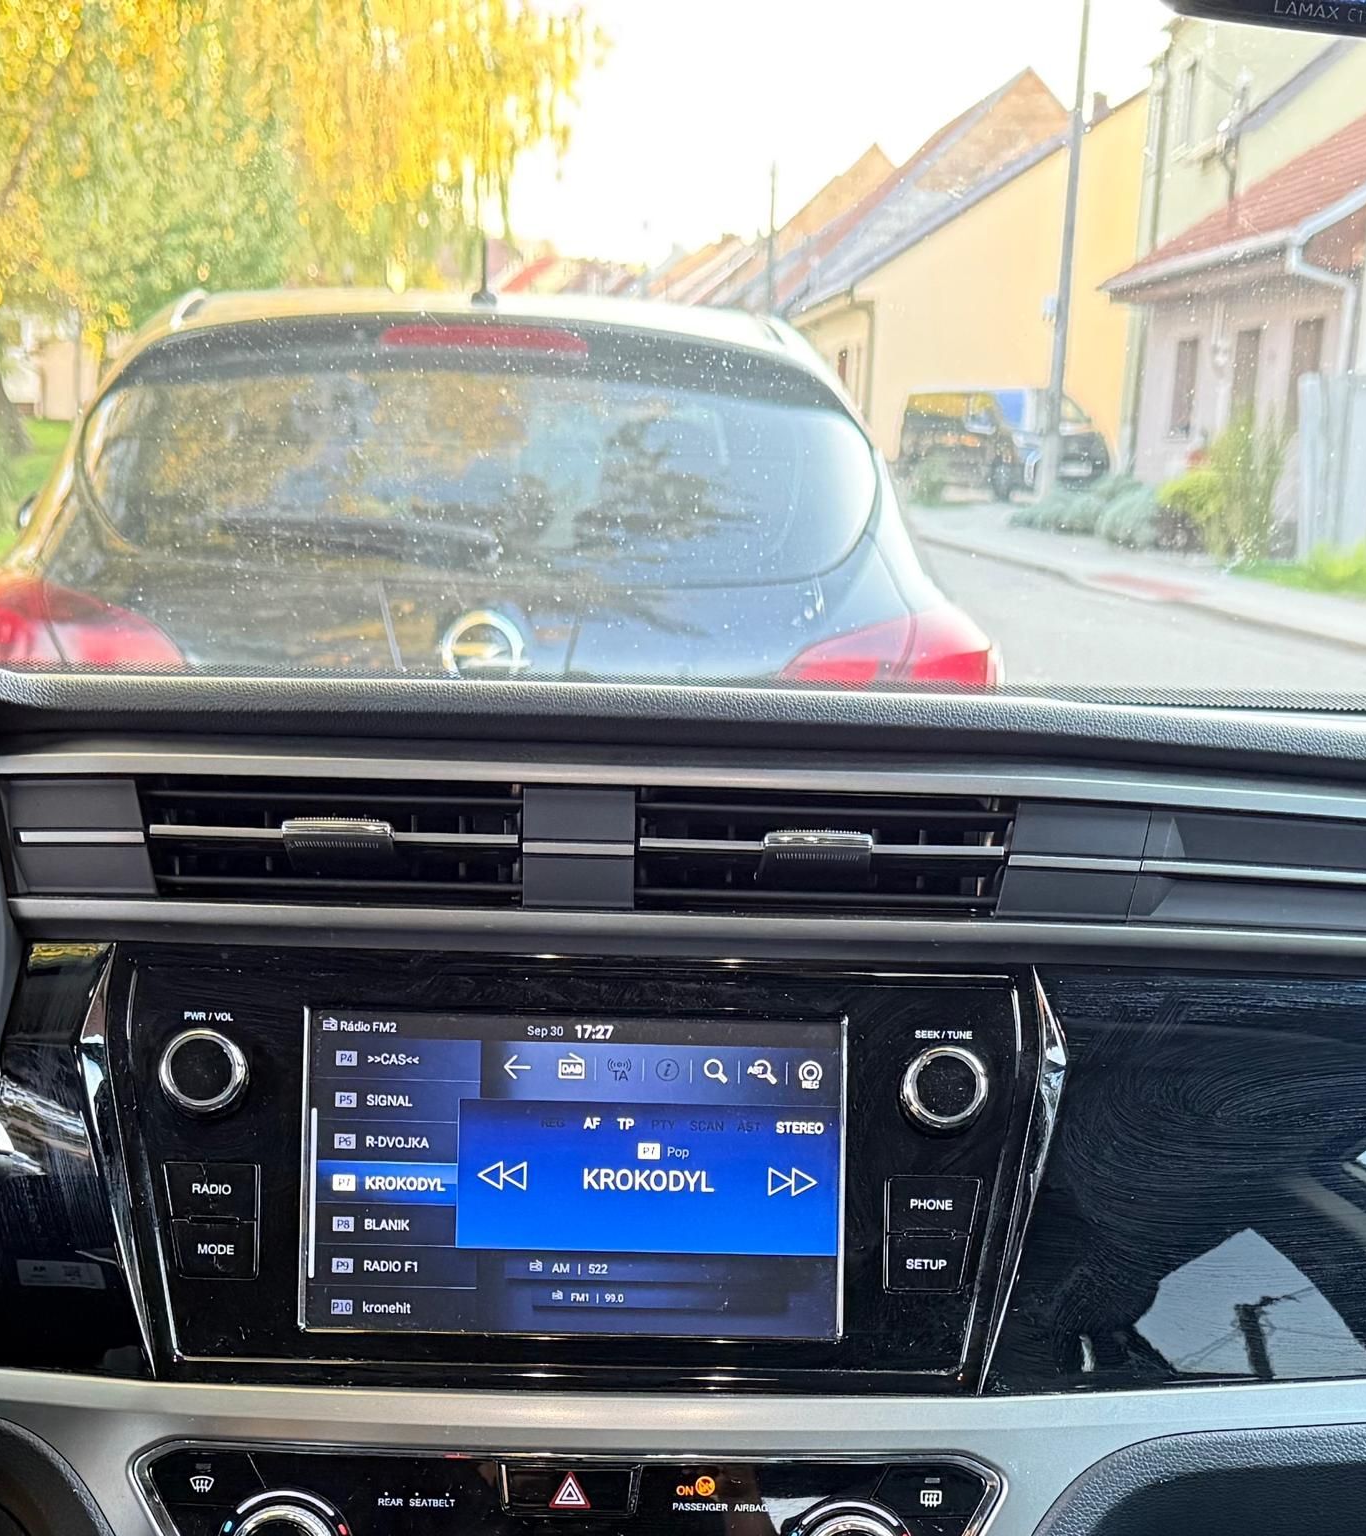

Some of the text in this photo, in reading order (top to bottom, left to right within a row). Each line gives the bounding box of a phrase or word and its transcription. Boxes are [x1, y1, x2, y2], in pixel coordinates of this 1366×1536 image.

[1273, 1, 1339, 19] LAMAX
[183, 1011, 206, 1021] PWR
[214, 1012, 234, 1022] VOL
[339, 1020, 396, 1033] Rádio FM2
[527, 1024, 613, 1039] Sep 30 17:27
[914, 1029, 940, 1040] SEEK
[947, 1030, 972, 1040] TUNE
[339, 1053, 353, 1063] P4
[561, 1063, 582, 1075] DAB
[611, 1070, 629, 1081] TA
[801, 1080, 820, 1089] REC
[339, 1094, 412, 1107] P5 SIGNAL
[583, 1117, 601, 1130] AF
[616, 1117, 635, 1130] TP
[775, 1121, 824, 1134] STEREO
[365, 1135, 429, 1148] R-DVOJKA
[666, 1145, 689, 1159] Pop
[364, 1175, 446, 1191] KROKODYL
[582, 1167, 715, 1192] KROKODYL
[191, 1182, 232, 1195] RADIO
[909, 1198, 953, 1211] PHONE
[364, 1218, 409, 1231] BLANIK
[196, 1243, 234, 1256] MODE
[363, 1259, 401, 1272] RADIO
[404, 1260, 418, 1273] F1
[551, 1262, 570, 1274] AM
[588, 1263, 608, 1275] 522
[904, 1258, 947, 1271] SETUP
[570, 1292, 590, 1302] FM1
[604, 1293, 624, 1304] 99.0
[332, 1300, 411, 1314] P10 kronehit
[676, 1484, 695, 1497] ON
[377, 1497, 455, 1509] REAR SEATBELT
[672, 1501, 769, 1514] PASSENGER AIRBAG
